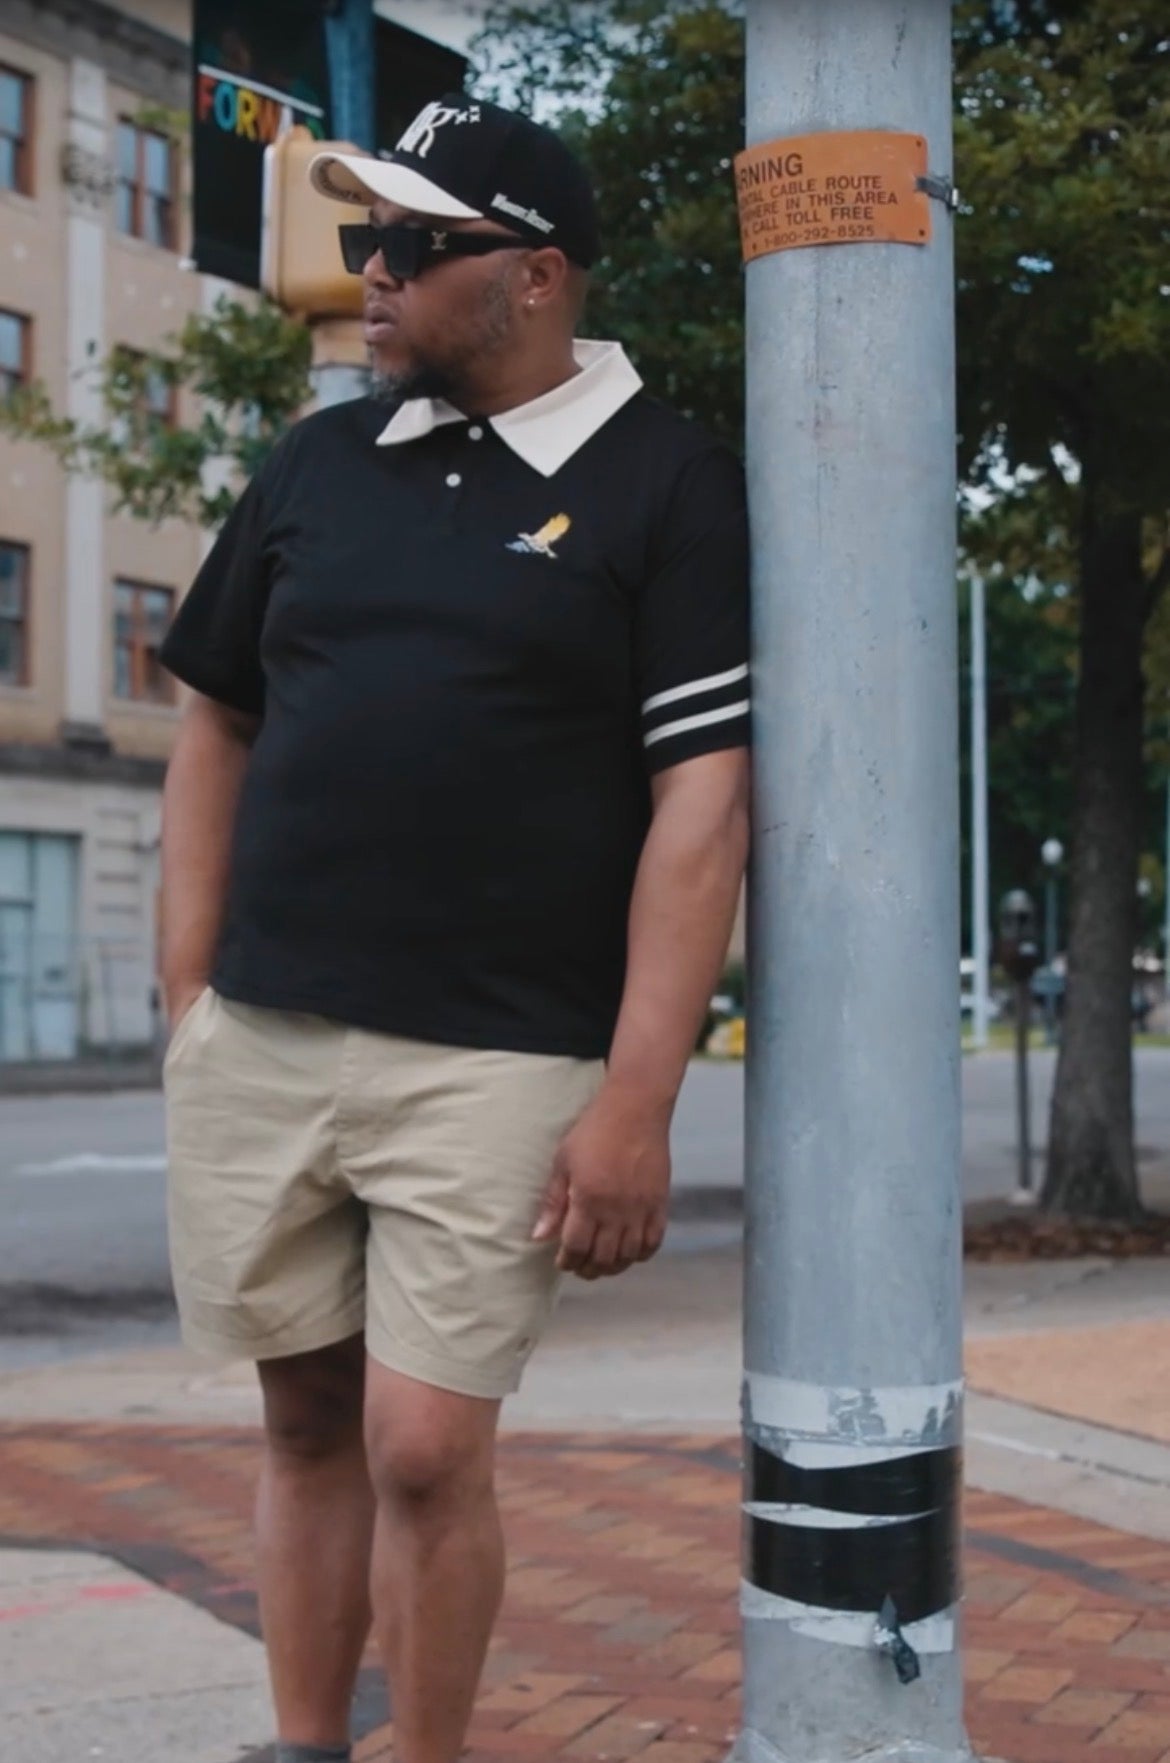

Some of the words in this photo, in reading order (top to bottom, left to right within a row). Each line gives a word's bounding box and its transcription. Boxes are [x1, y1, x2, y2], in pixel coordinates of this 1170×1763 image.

[739, 153, 803, 190] RNING
[770, 178, 817, 198] CABLE
[825, 175, 882, 191] ROUTE
[785, 197, 800, 211] IN
[808, 191, 845, 207] THIS
[854, 191, 898, 205] AREA
[752, 216, 779, 234] CALL
[785, 209, 820, 226] TOLL
[831, 206, 874, 221] FREE
